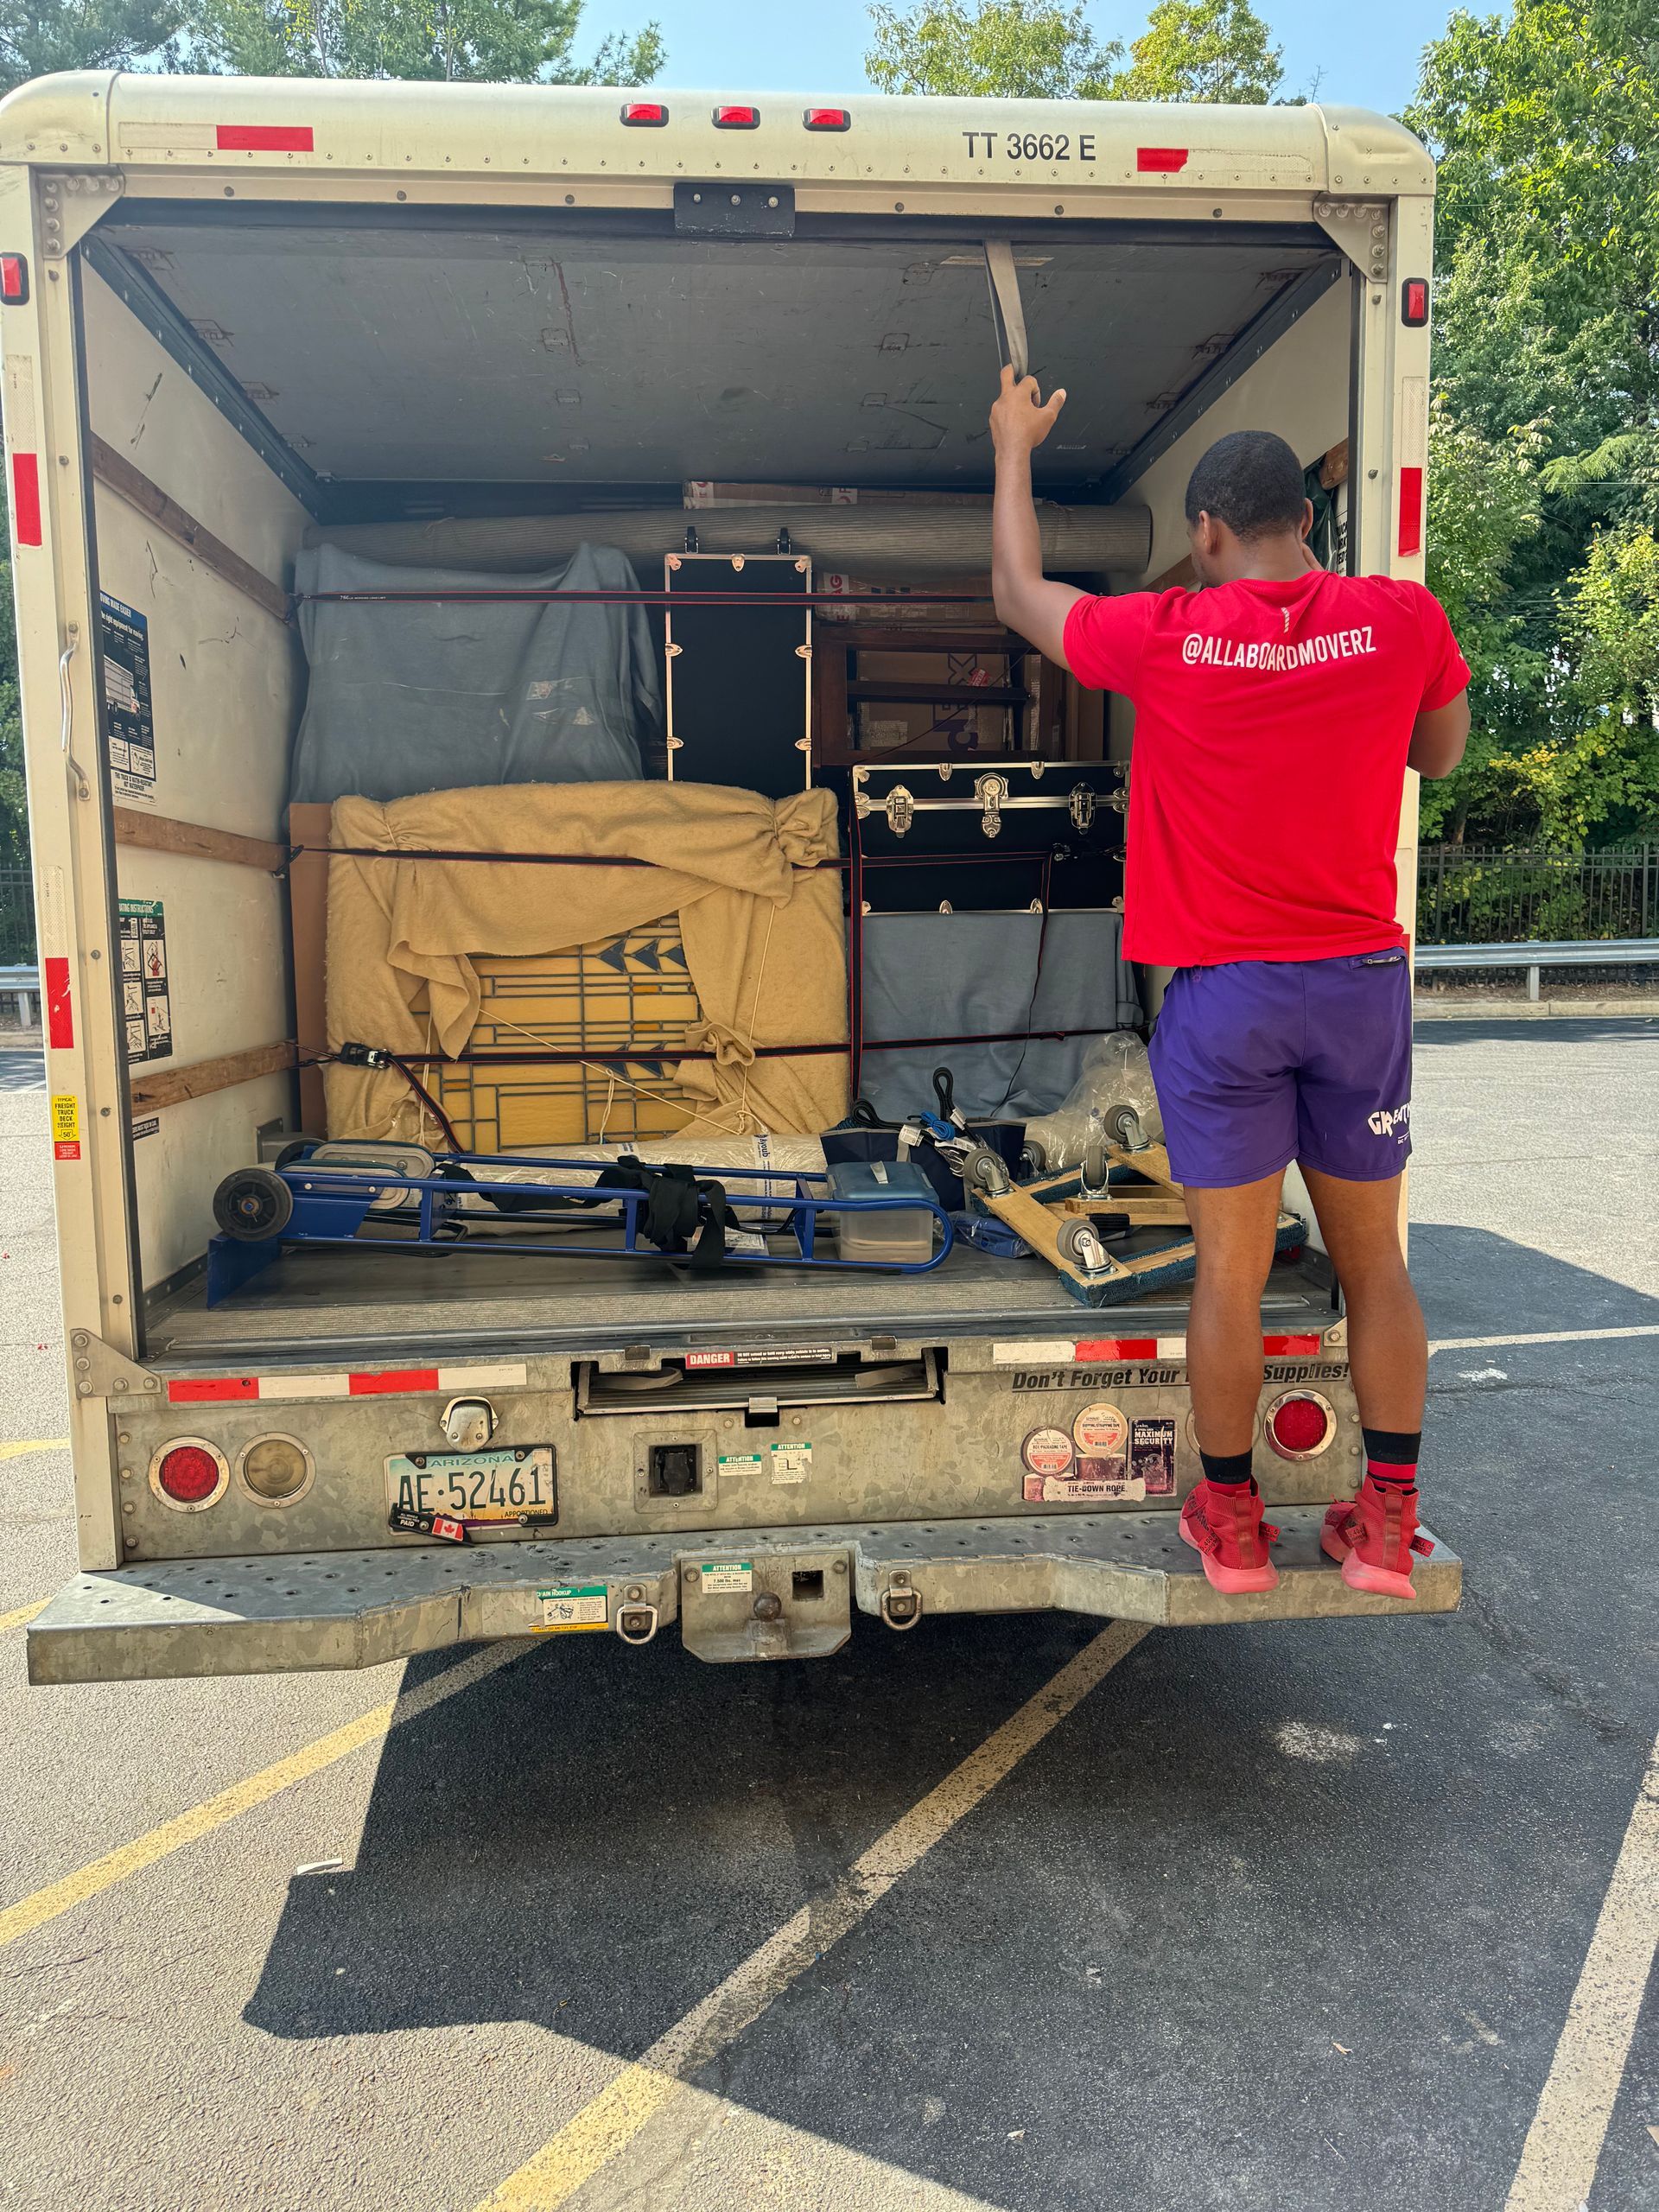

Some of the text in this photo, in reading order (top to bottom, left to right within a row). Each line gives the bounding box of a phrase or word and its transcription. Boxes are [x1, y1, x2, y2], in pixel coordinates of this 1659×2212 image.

[962, 131, 1096, 161] TT 3662 E
[1181, 626, 1377, 672] @ALLABOARDMOVERZ
[690, 1353, 730, 1365] DANGER
[1012, 1371, 1065, 1389] Don't
[1070, 1369, 1133, 1389] Forget
[1138, 1368, 1181, 1384] Your
[1263, 1363, 1349, 1383] Supplies!
[430, 1454, 515, 1467] ARIZONA
[400, 1519, 416, 1528] PAID
